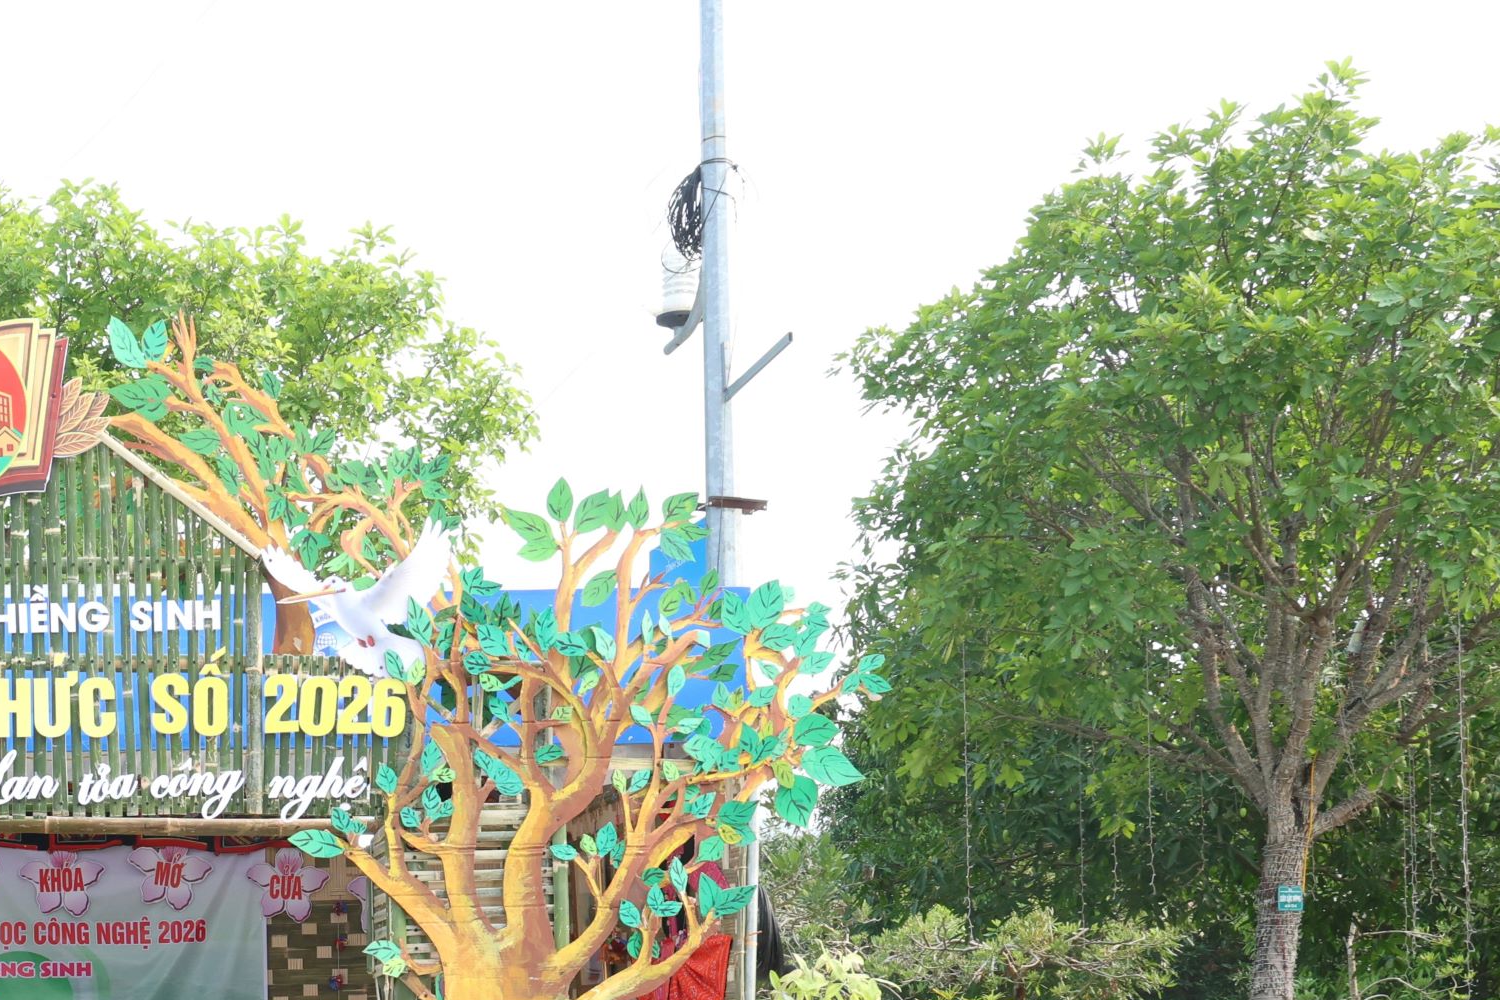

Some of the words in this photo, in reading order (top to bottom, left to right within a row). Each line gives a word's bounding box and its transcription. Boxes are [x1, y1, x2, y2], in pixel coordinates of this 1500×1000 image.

[130, 599, 222, 633] SINH
[150, 646, 229, 737] SỐ
[264, 674, 407, 738] 2026
[77, 763, 138, 806] tỏa
[150, 758, 246, 820] công
[268, 756, 368, 823] nghệ
[39, 862, 85, 893] KHÓA
[154, 854, 186, 888] MỞ
[269, 865, 303, 900] CỬA
[34, 918, 90, 946] CÔNG
[96, 917, 152, 950] NGHỆ
[158, 919, 206, 945] 2026
[40, 962, 93, 978] SINH
